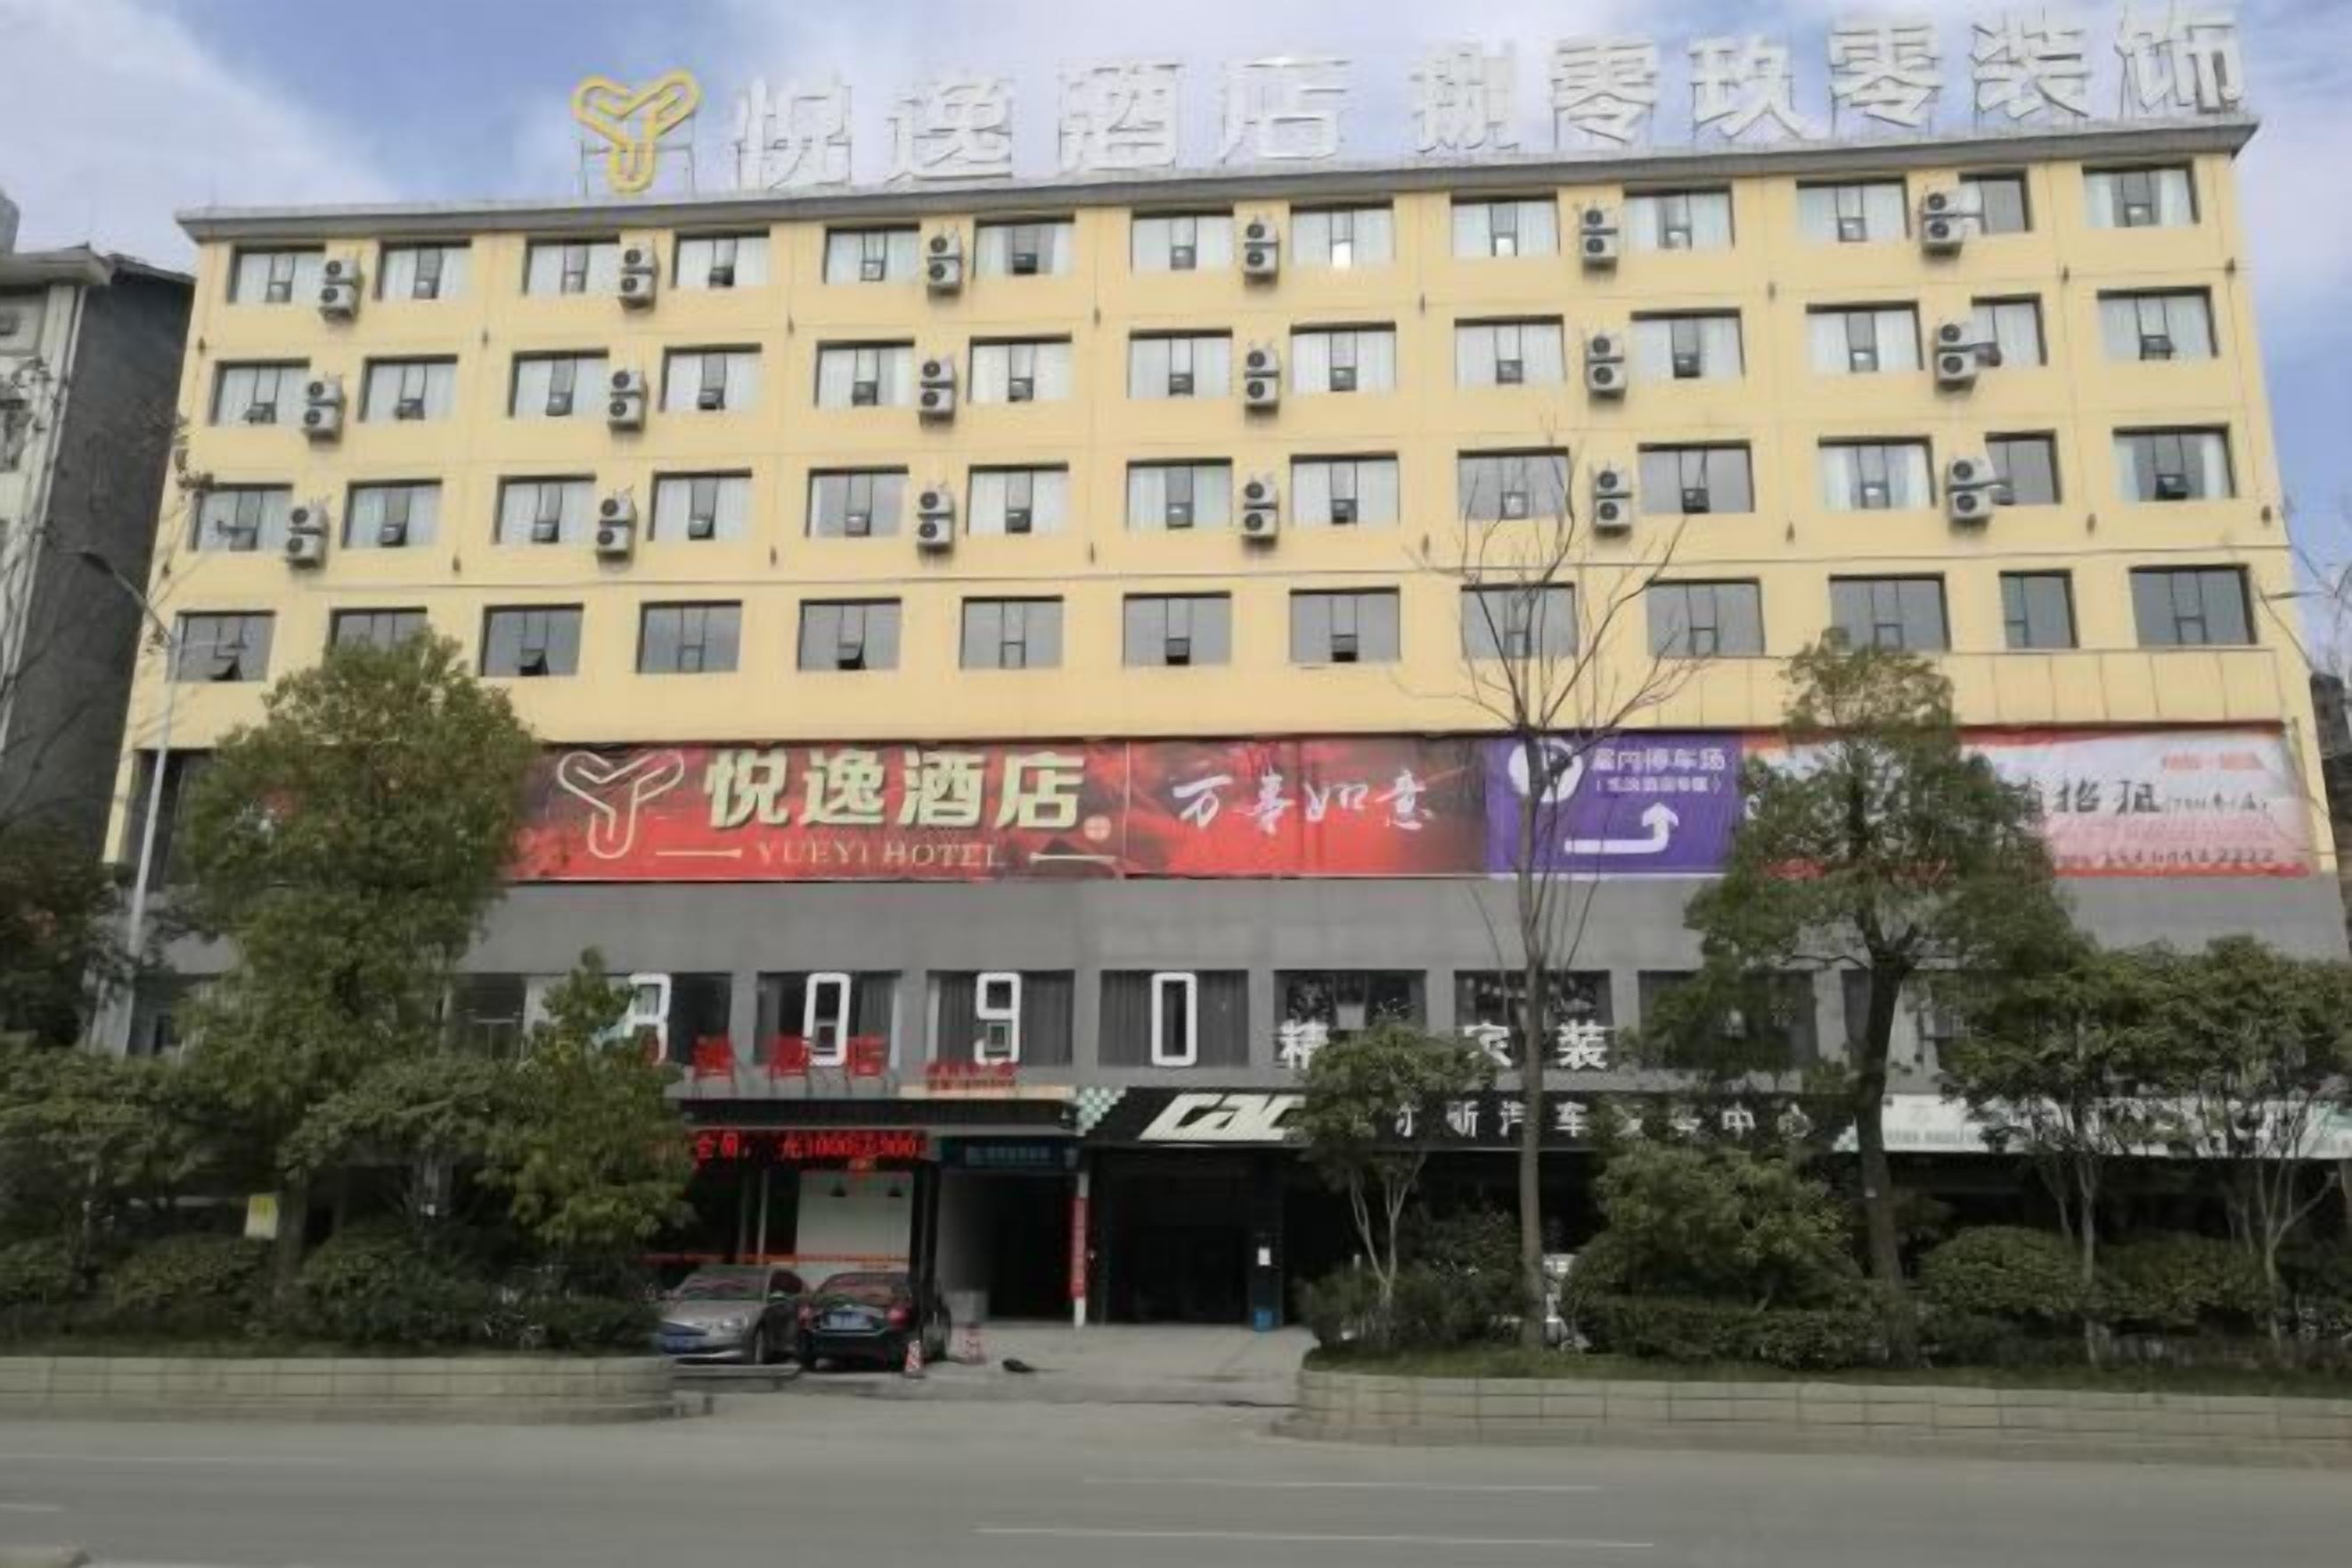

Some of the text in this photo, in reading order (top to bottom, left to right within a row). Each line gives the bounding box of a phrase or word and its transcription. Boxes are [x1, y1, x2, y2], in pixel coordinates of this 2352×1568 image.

[734, 55, 1351, 191] 悦逸酒店
[704, 747, 1085, 829] 悦逸酒店
[758, 840, 1007, 867] YUEYI HOTEL
[1278, 1018, 1607, 1070] 精家装
